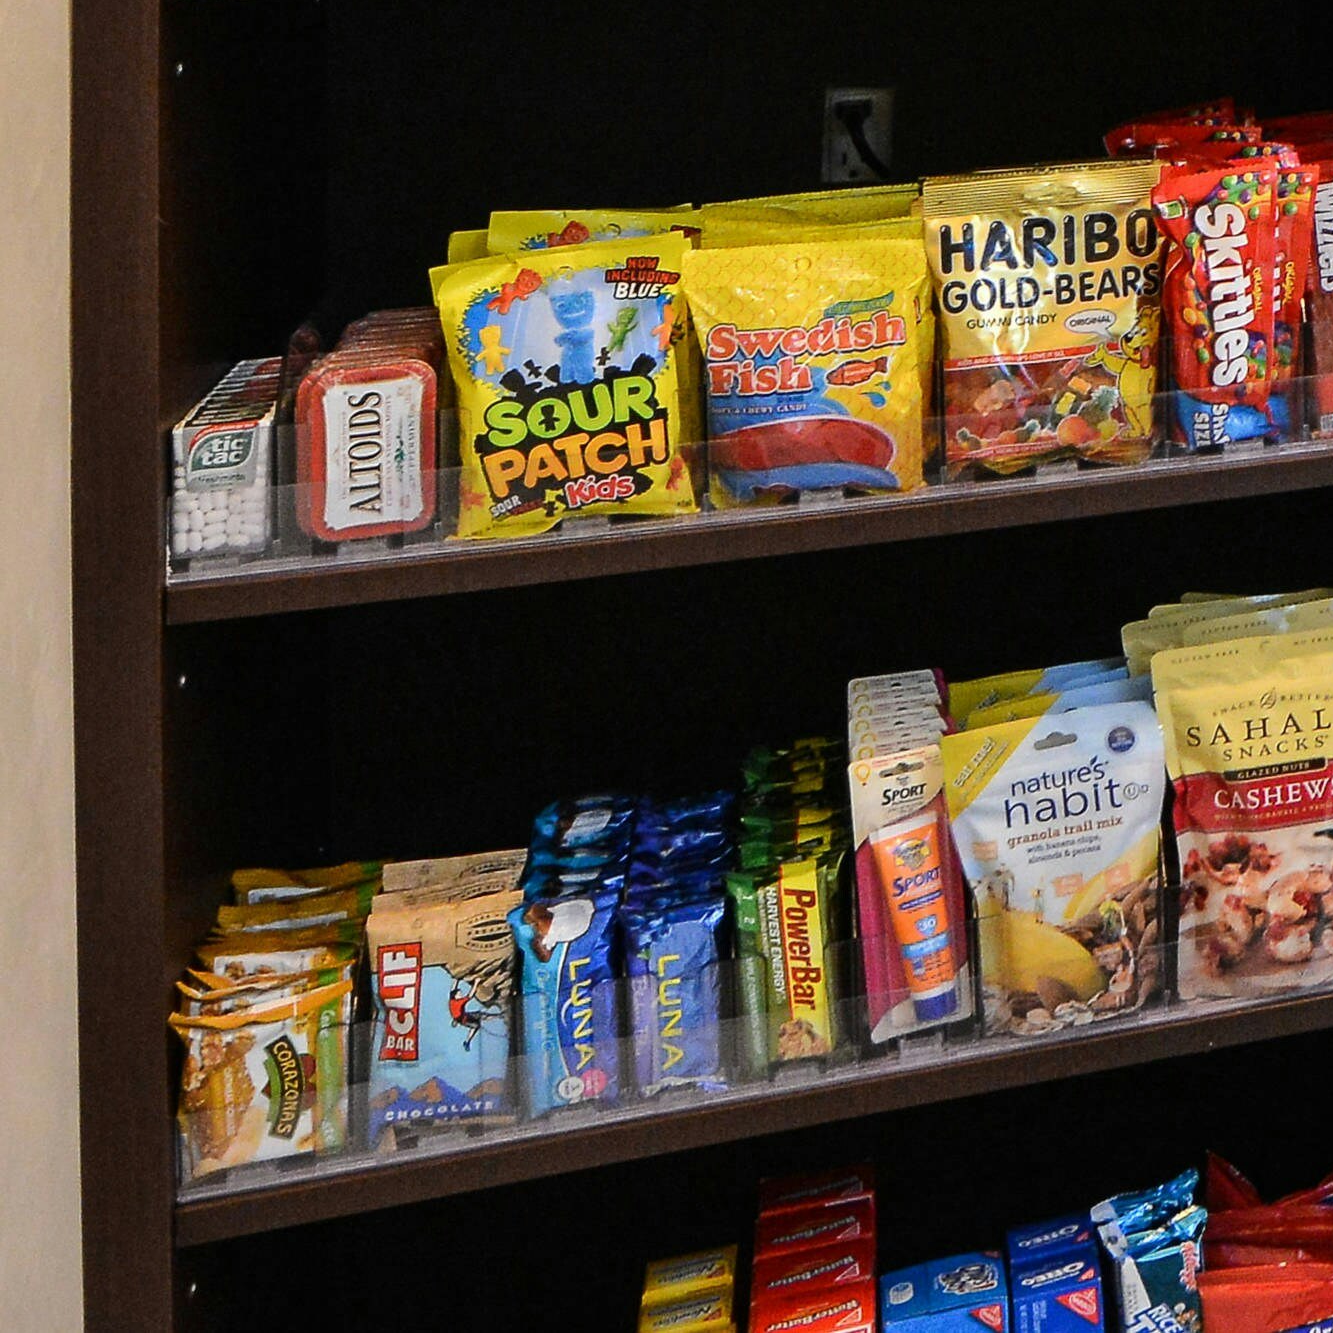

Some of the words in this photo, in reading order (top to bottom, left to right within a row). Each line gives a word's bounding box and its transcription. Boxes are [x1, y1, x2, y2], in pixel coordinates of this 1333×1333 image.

[940, 209, 1158, 274] HARIBO
[614, 282, 663, 299] BLUE
[942, 263, 1160, 314] GOLD-BEARS
[1194, 203, 1258, 387] Skittles
[707, 311, 906, 360] Swedish
[1015, 313, 1057, 326] CANDY
[1069, 315, 1111, 328] ORIGINAL
[707, 356, 812, 396] Fish
[487, 376, 655, 448] SOUR
[348, 391, 382, 513] ALTOIDS
[484, 418, 666, 498] PATCH
[565, 475, 634, 508] Kids
[1222, 734, 1326, 762] SNACKS
[1003, 777, 1123, 829] habit
[383, 951, 419, 1035] CLIF
[567, 957, 596, 1070] LUNA
[657, 954, 684, 1070] LUNA
[386, 1036, 414, 1051] BAR
[271, 1040, 301, 1136] CORAZONAS
